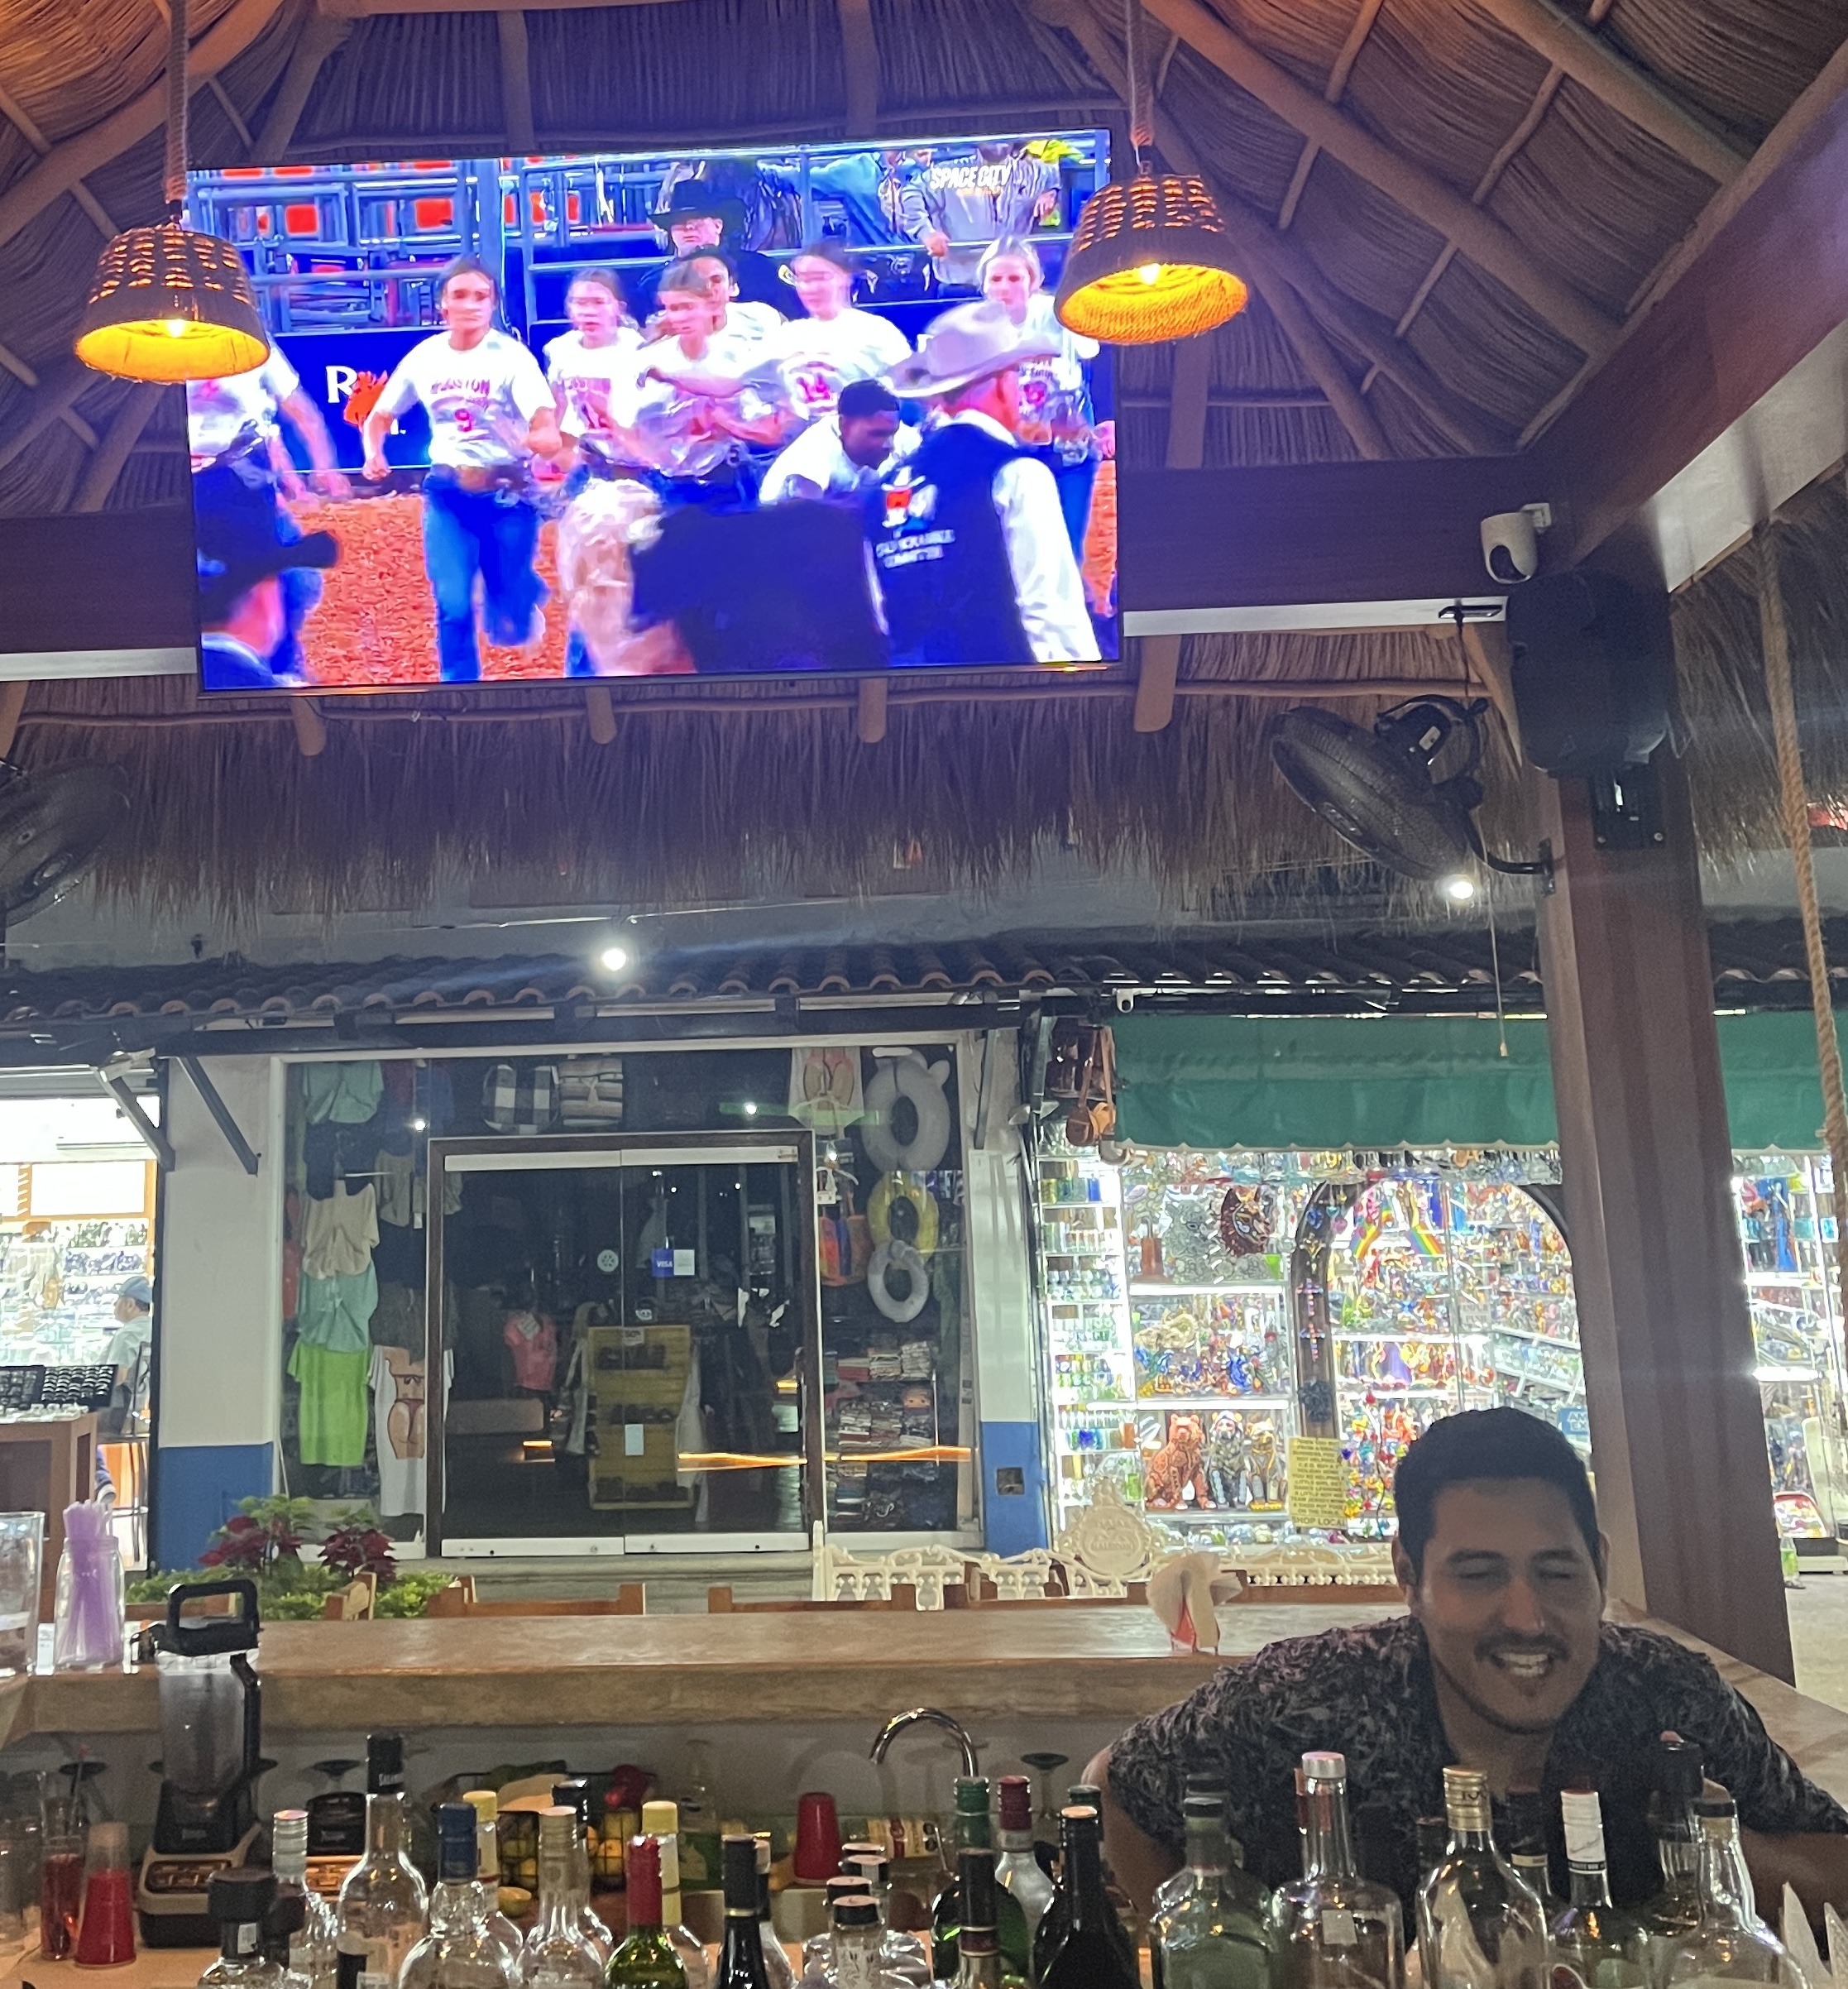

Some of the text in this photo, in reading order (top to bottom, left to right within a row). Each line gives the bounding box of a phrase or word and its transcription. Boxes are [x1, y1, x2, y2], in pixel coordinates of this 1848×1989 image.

[930, 165, 1011, 189] SPACE CITY
[1318, 1517, 1345, 1526] LOCAL
